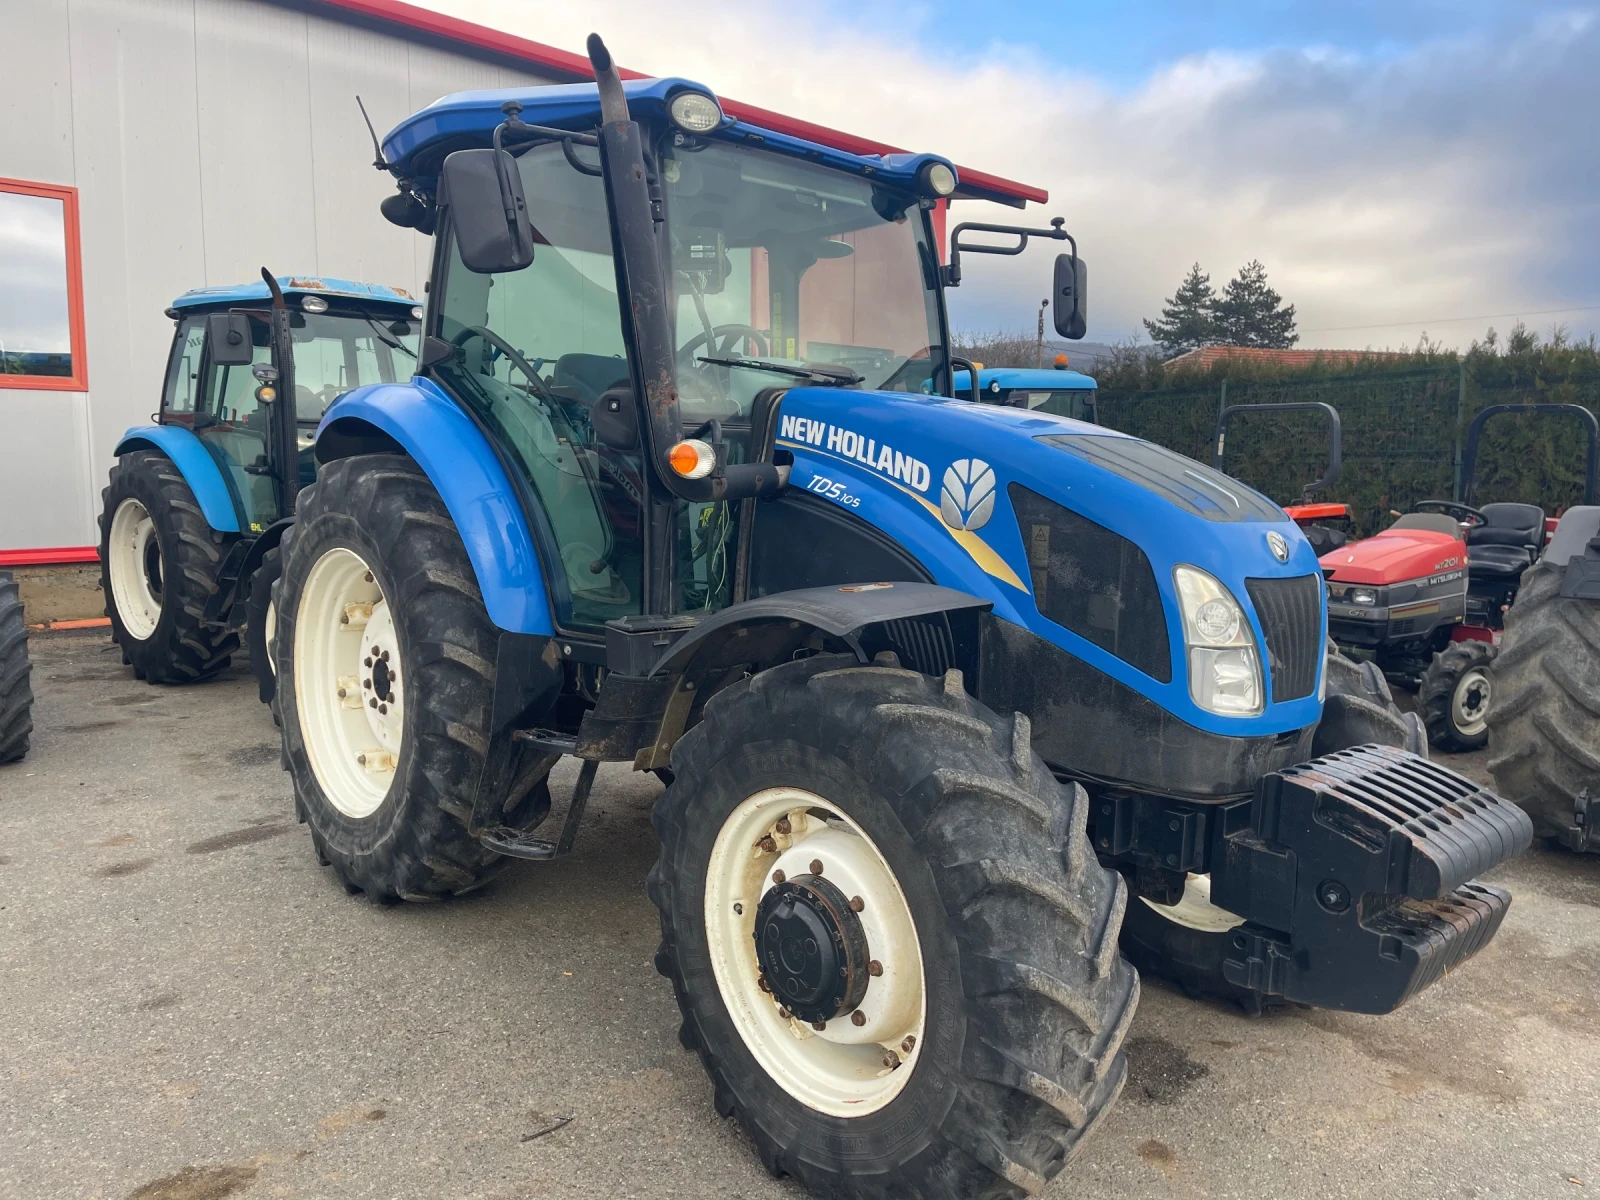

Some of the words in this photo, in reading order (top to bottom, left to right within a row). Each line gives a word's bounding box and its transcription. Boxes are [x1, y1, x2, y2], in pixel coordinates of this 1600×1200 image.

[781, 415, 826, 448] NEW
[827, 424, 931, 493] HOLLAND
[1430, 571, 1462, 585] MITSUBISHI
[1434, 556, 1459, 571] MT201
[927, 960, 955, 1094] AGRIBIB
